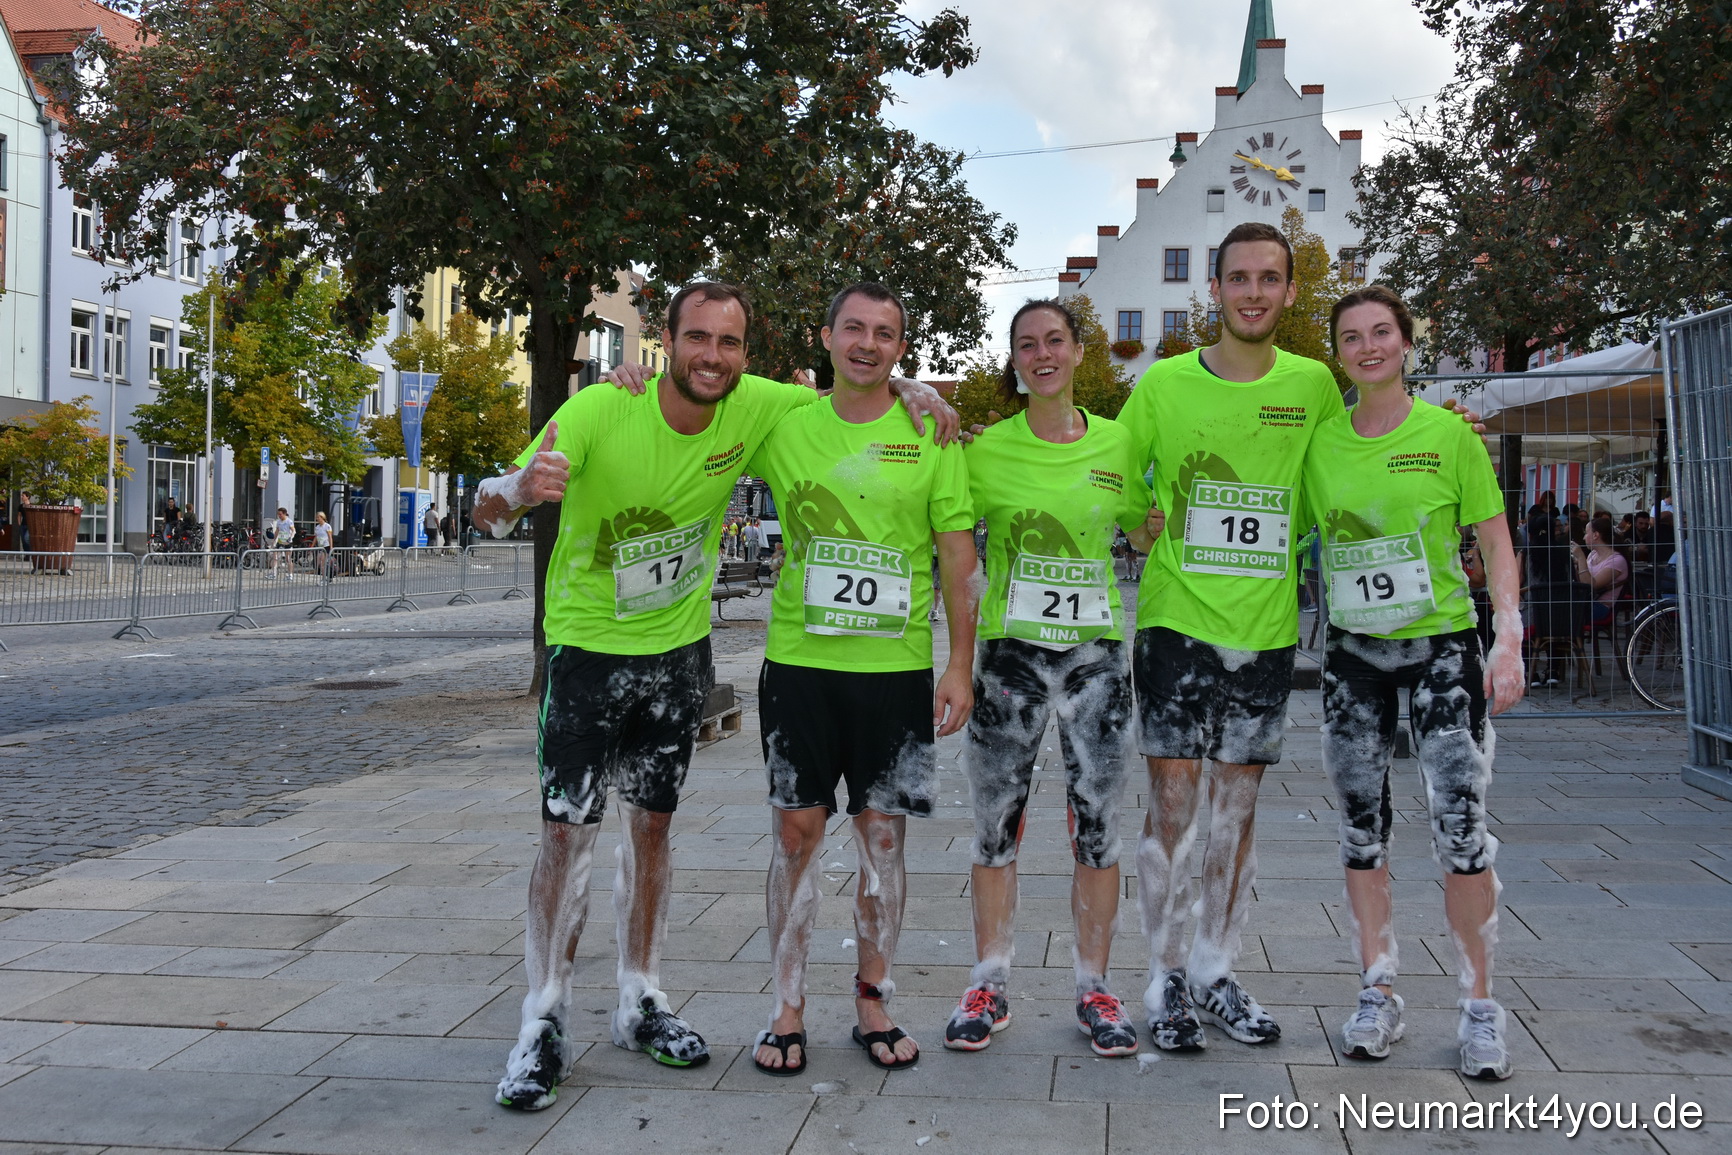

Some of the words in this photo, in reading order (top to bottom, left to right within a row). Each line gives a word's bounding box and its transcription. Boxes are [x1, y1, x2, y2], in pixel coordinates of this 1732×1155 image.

[1259, 413, 1307, 421] ELEMENTELAUF
[1261, 405, 1306, 413] NEUMARKTER
[704, 447, 745, 471] ELEMENTELAUF
[706, 441, 744, 463] NEUMARKTER
[1387, 459, 1442, 468] ELEMENTELAUF
[1391, 452, 1440, 460] NEUMARKTER
[1196, 484, 1285, 512] BOCK
[1220, 516, 1260, 544] 18
[619, 523, 705, 566] BOCK
[814, 541, 903, 575] BOCK
[1193, 549, 1278, 567] CHRISTOPH
[1332, 537, 1416, 569] BOCK
[648, 555, 684, 585] 17
[1020, 557, 1105, 584] BOCK
[833, 574, 878, 606] 20
[1355, 572, 1395, 602] 19
[824, 611, 879, 628] PETER
[1041, 591, 1080, 621] 21
[1039, 626, 1080, 641] NINA
